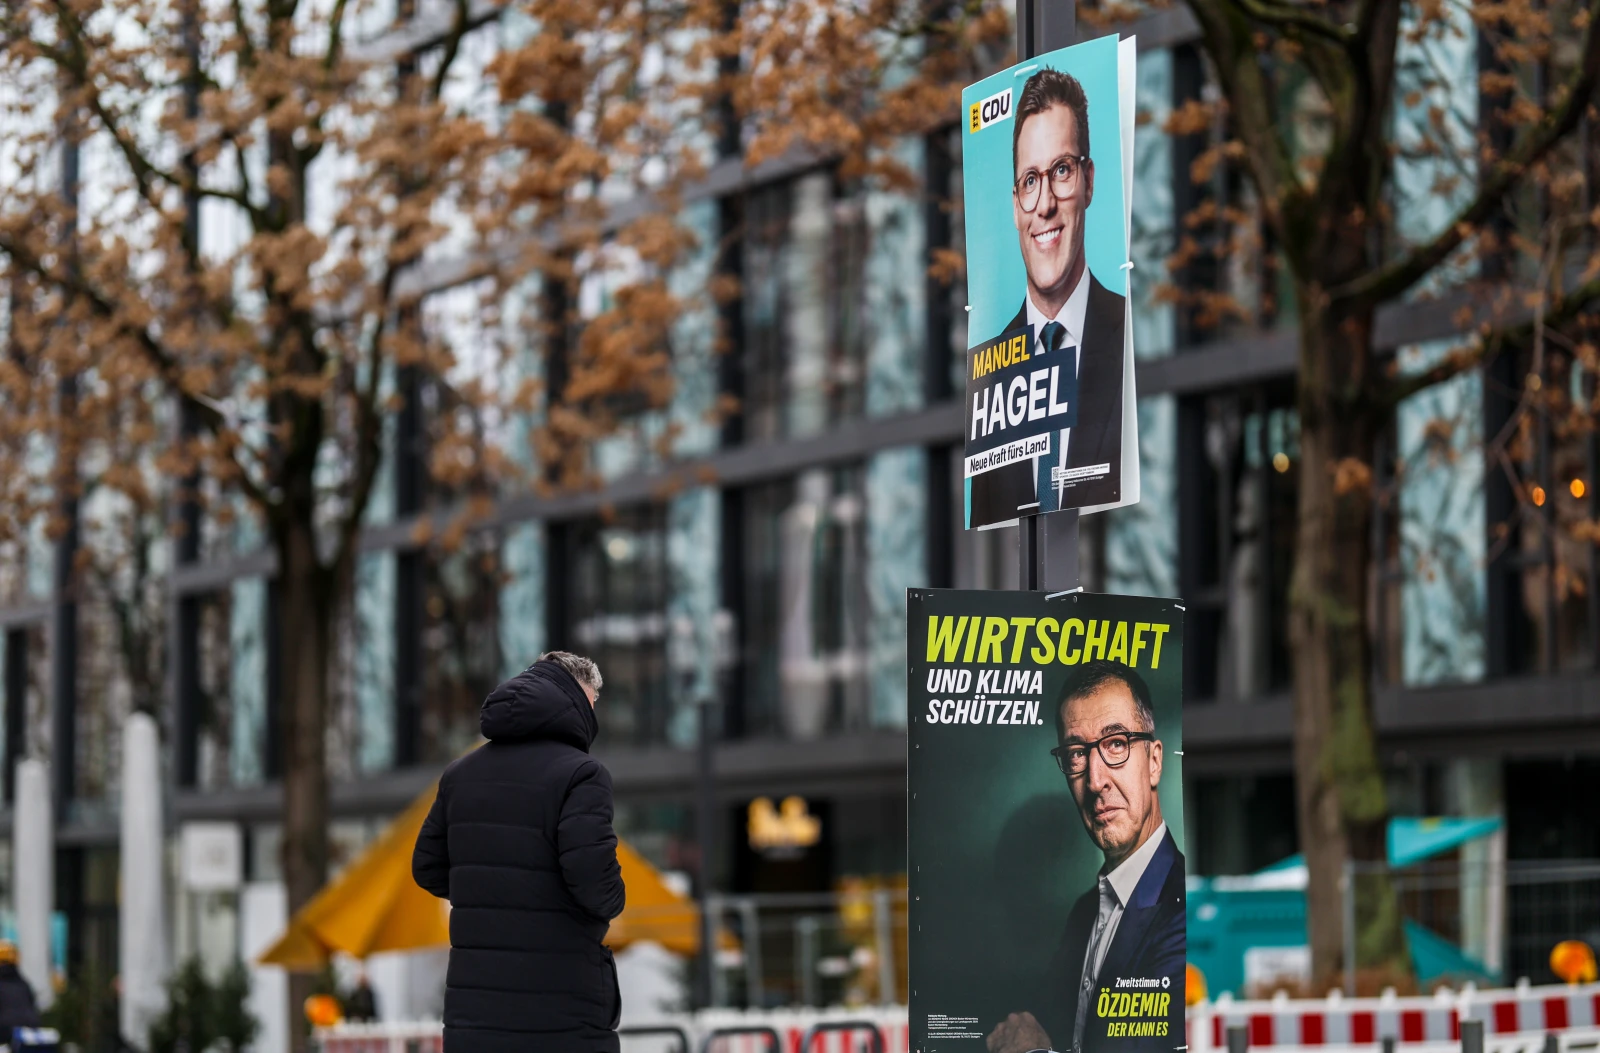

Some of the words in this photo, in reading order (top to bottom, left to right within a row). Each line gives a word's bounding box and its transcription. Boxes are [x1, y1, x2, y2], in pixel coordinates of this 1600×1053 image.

[982, 93, 1010, 123] CDU
[973, 334, 1030, 380] MANUEL
[971, 365, 1068, 441] HAGEL
[970, 457, 988, 473] Neue
[988, 447, 1006, 467] Kraft
[1007, 444, 1024, 460] fürs
[1025, 436, 1048, 455] Land
[926, 615, 1170, 669] WIRTSCHAFT
[926, 668, 972, 693] UND
[975, 669, 1043, 695] KLIMA
[926, 694, 1043, 725] SCHÜTZEN.
[1115, 976, 1160, 988] Zweitstimme
[1097, 987, 1171, 1018] ÖZDEMIR
[1107, 1022, 1127, 1037] DER
[1127, 1021, 1155, 1037] KANN
[1155, 1021, 1169, 1037] ES
